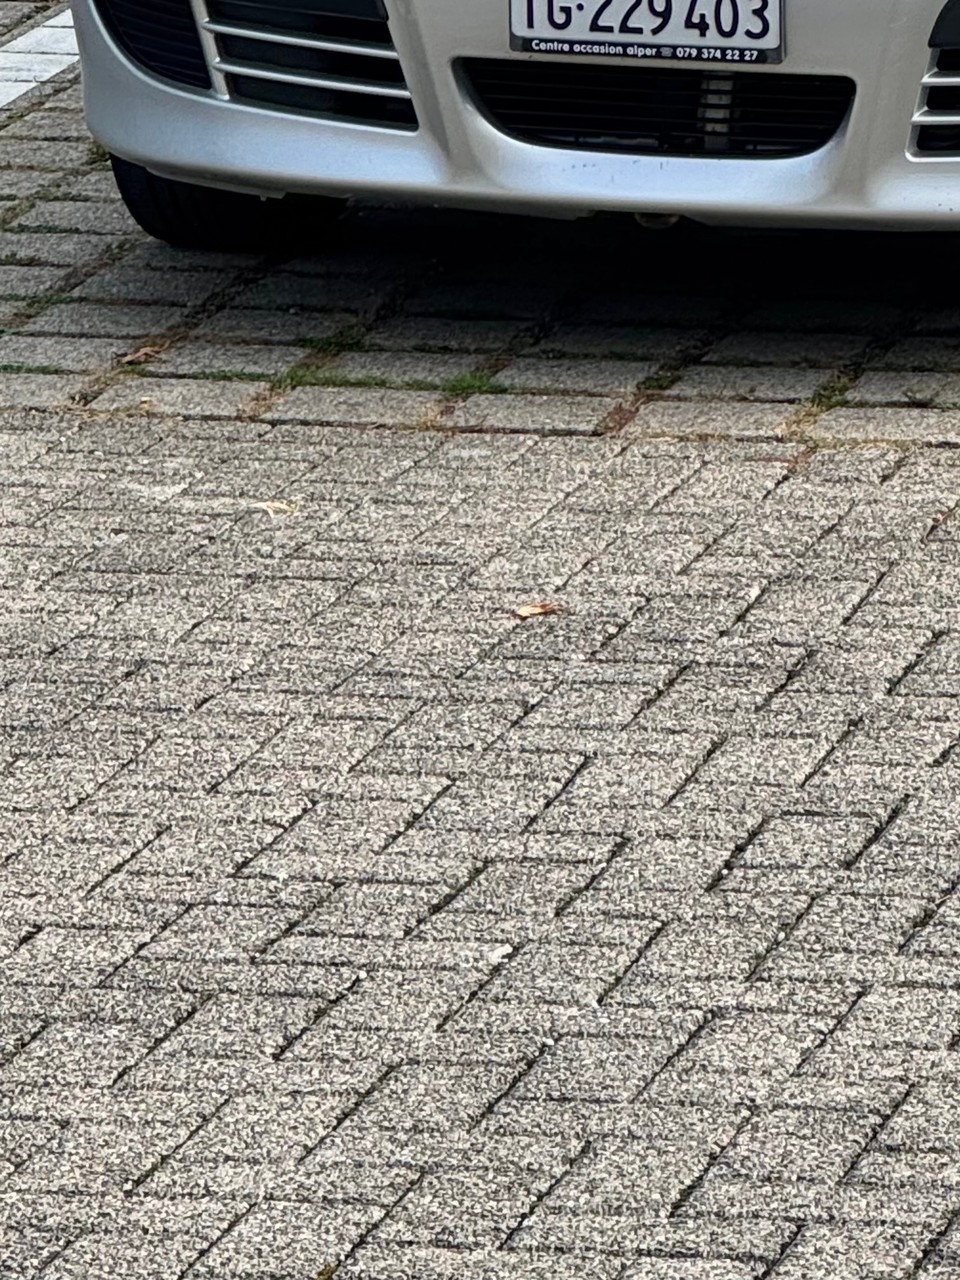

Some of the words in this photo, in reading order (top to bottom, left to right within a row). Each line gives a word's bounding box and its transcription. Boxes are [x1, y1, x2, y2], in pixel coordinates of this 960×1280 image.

[531, 40, 570, 52] Centre
[573, 43, 623, 54] occasion
[626, 45, 657, 57] alper
[676, 47, 698, 58] 079
[701, 48, 721, 59] 374
[725, 50, 740, 60] 22
[743, 50, 758, 61] 27
